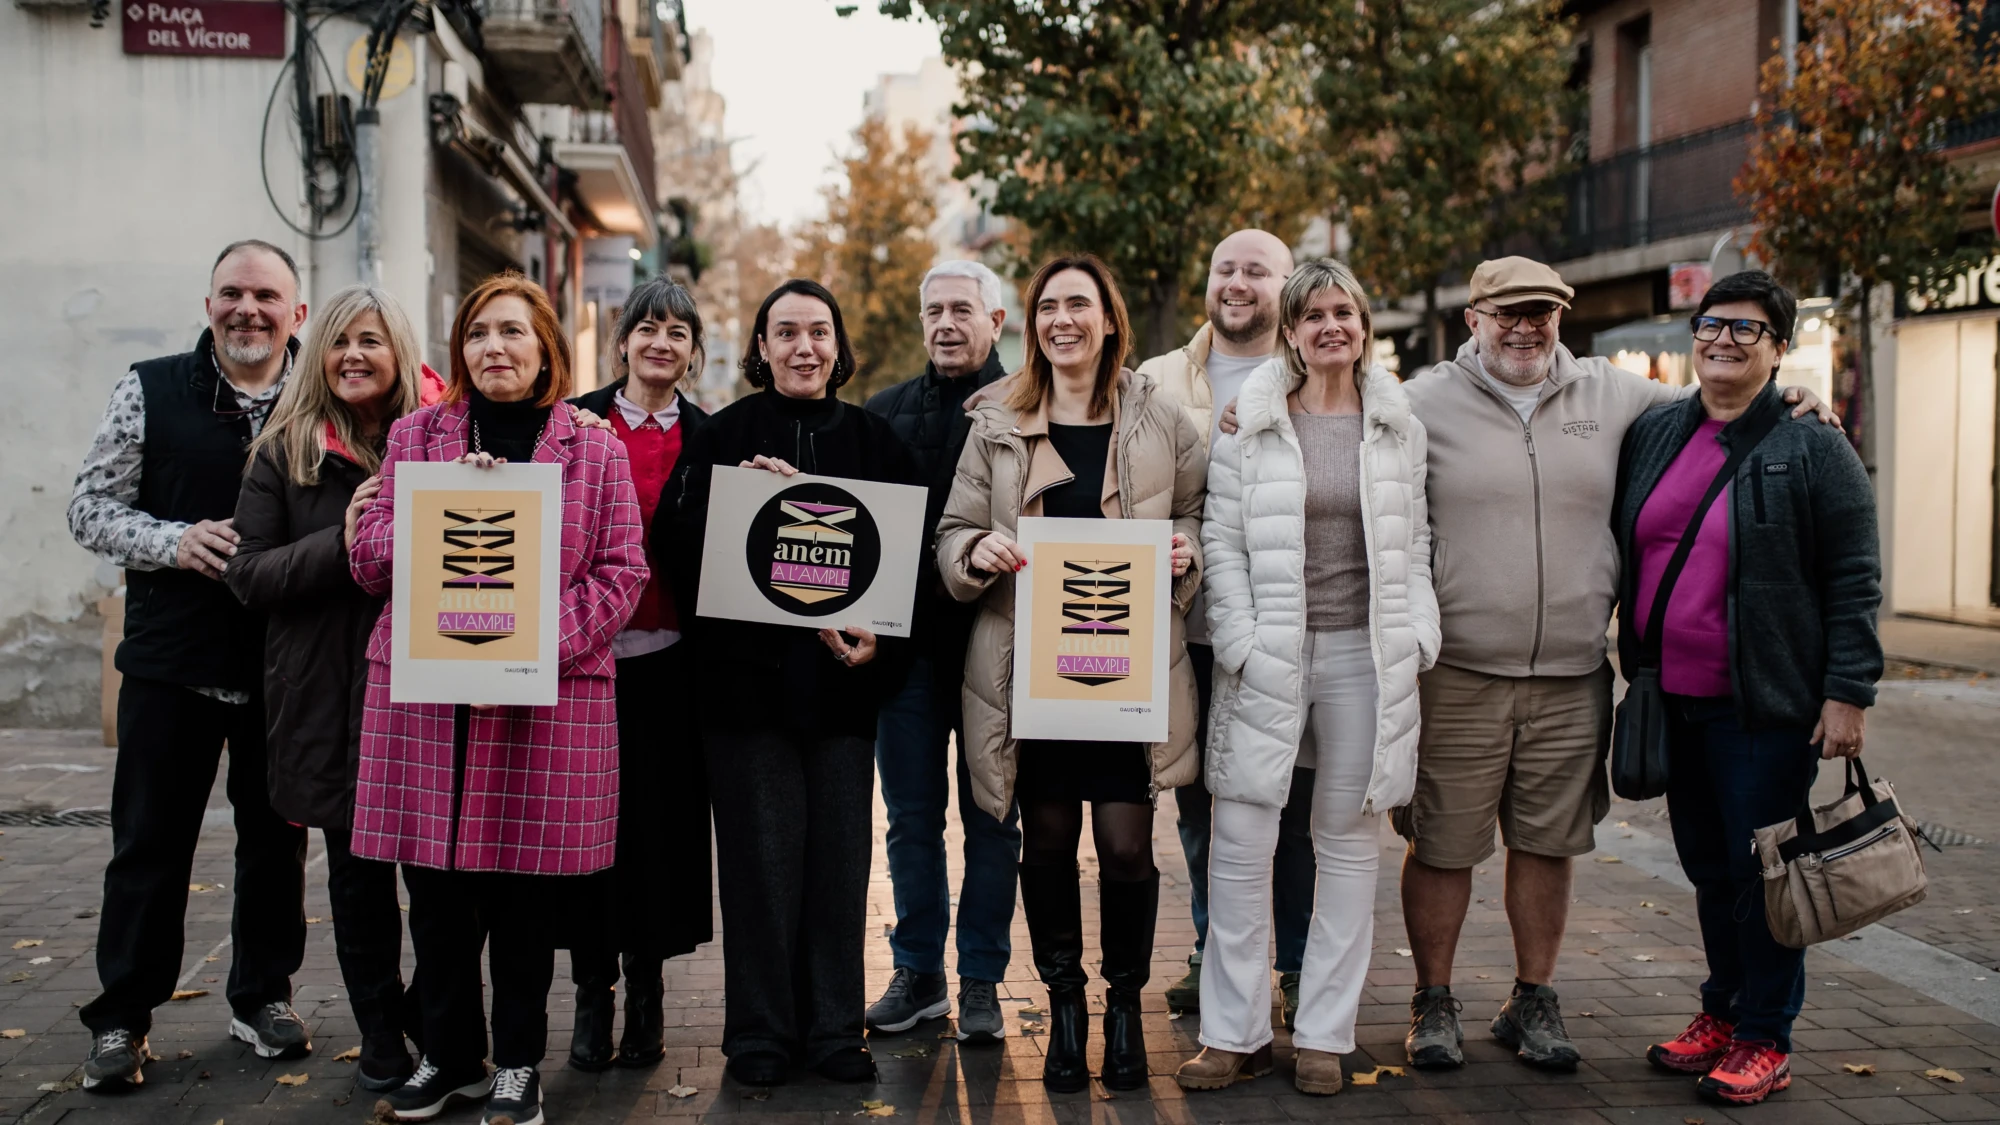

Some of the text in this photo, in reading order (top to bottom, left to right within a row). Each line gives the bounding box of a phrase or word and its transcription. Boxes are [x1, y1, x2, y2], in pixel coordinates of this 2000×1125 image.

[773, 542, 852, 566] anem
[771, 565, 850, 586] A L'AMPLE
[438, 591, 515, 610] anem
[438, 614, 515, 630] A L'AMPLE
[1057, 636, 1130, 654] anem
[1057, 657, 1130, 673] A L'AMPLE
